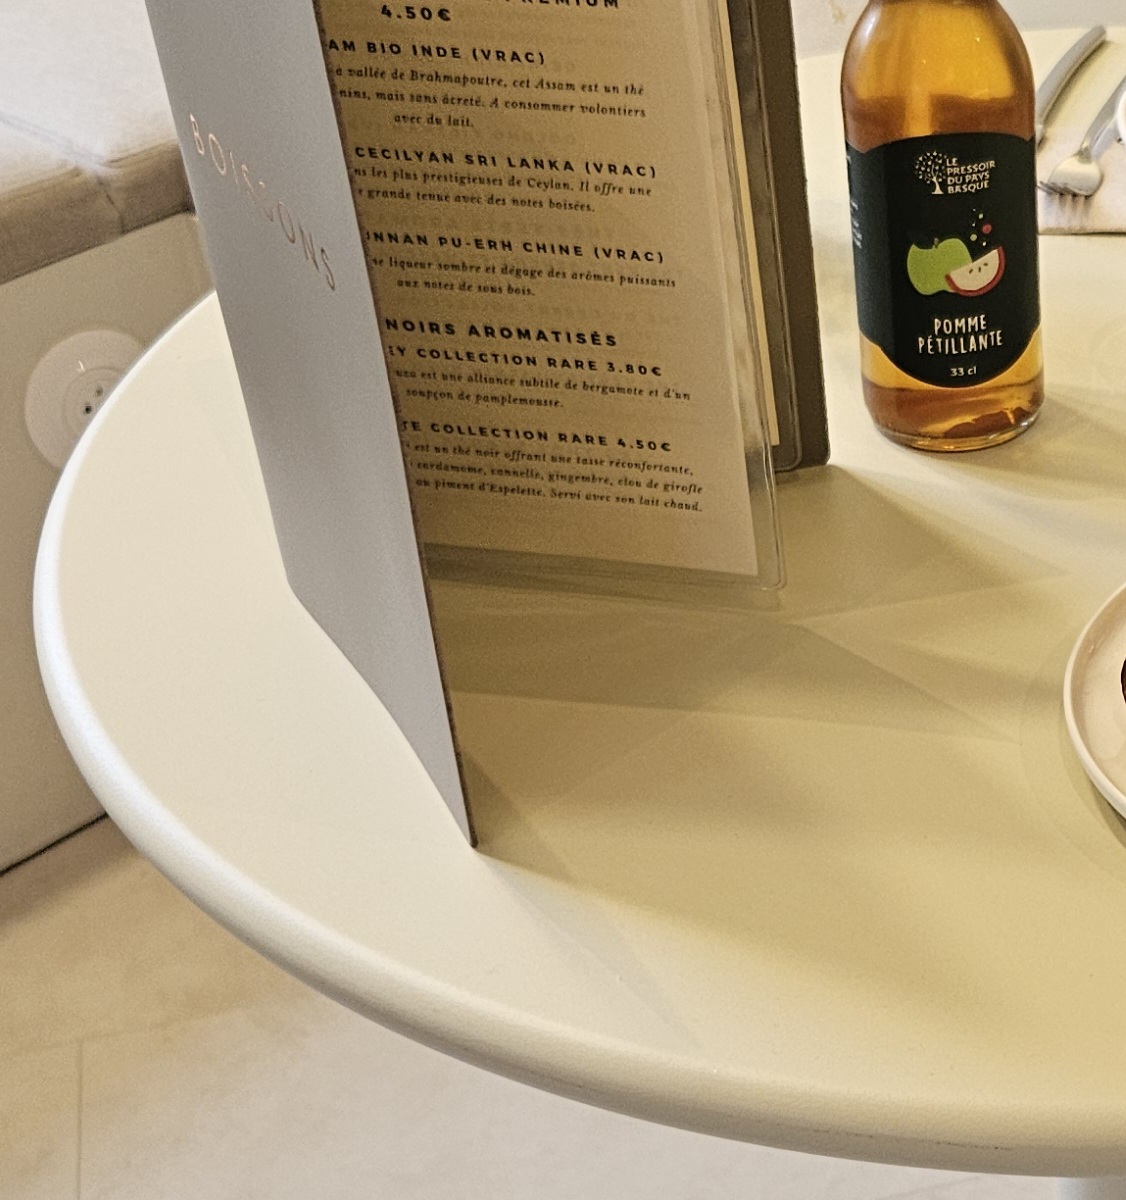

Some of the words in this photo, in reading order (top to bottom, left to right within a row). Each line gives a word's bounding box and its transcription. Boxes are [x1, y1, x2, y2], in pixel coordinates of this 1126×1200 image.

[381, 4, 451, 21] 4.50€
[328, 39, 356, 52] AM
[366, 42, 402, 55] BIO
[411, 44, 462, 59] INDE
[472, 48, 545, 65] (VRAC)
[348, 67, 387, 79] vallée
[391, 69, 406, 81] de
[410, 69, 508, 88] Brahmapoutre,
[512, 77, 531, 89] cet
[535, 78, 576, 92] Assam
[581, 81, 599, 93] est
[604, 84, 620, 95] un
[624, 82, 645, 96] thé
[339, 88, 371, 101] nins,
[375, 90, 405, 102] mais
[410, 94, 439, 104] sans
[504, 100, 575, 113] consommer
[580, 102, 647, 118] volontiers
[394, 114, 423, 125] avec
[427, 113, 442, 126] du
[354, 146, 455, 164] CECILYAN
[464, 154, 497, 167] SRI
[506, 156, 575, 172] LANKA
[585, 161, 656, 178] (VRAC)
[946, 157, 958, 166] LE
[947, 160, 996, 175] PRESSOIR
[371, 166, 388, 179] les
[392, 169, 418, 185] plus
[423, 172, 504, 187] prestigieuses
[508, 175, 522, 187] de
[579, 180, 590, 192] Il
[594, 182, 624, 196] offre
[629, 187, 652, 197] une
[947, 175, 963, 185] DU
[965, 171, 990, 183] PAYS
[947, 180, 990, 194] BASQUE
[367, 187, 412, 201] grande
[416, 191, 450, 202] tenue
[454, 194, 483, 205] avec
[487, 193, 507, 206] des
[512, 196, 544, 209] notes
[366, 231, 429, 246] NNAN
[438, 236, 513, 252] PU-ERH
[522, 241, 584, 257] CHINE
[594, 246, 664, 265] (VRAC)
[388, 256, 433, 270] liqueur
[437, 261, 481, 273] sombre
[485, 264, 496, 275] et
[501, 263, 544, 279] dégage
[547, 266, 567, 279] des
[571, 270, 615, 282] arômes
[619, 273, 676, 288] puissants
[397, 279, 418, 288] aux
[423, 280, 455, 291] notes
[459, 280, 473, 292] de
[477, 284, 503, 295] sous
[507, 284, 536, 296] bois.
[385, 318, 456, 336] NOIRS
[468, 324, 617, 347] AROMATISÉS
[934, 314, 987, 336] POMME
[918, 330, 1003, 355] PÉTILLANTE
[416, 348, 538, 367] COLLECTION
[547, 357, 598, 371] RARE
[606, 362, 662, 377] 3.80€
[950, 367, 965, 377] 33
[967, 365, 977, 375] cl
[405, 388, 453, 401] soupçon
[458, 390, 471, 400] de
[421, 371, 437, 380] est
[442, 373, 463, 382] une
[467, 373, 516, 386] alliance
[519, 377, 559, 389] subtile
[565, 379, 578, 390] de
[582, 381, 644, 396] bergamote
[649, 387, 659, 398] et
[401, 420, 422, 432] TE
[430, 423, 549, 441] COLLECTION
[558, 432, 608, 446] RARE
[617, 438, 672, 452] 4.50€
[414, 443, 430, 452] est
[434, 445, 449, 454] un
[452, 444, 471, 456] thé
[475, 448, 501, 458] noir
[504, 450, 546, 462] offrant
[551, 455, 572, 464] une
[576, 456, 605, 466] tasse
[434, 479, 475, 491] piment
[550, 489, 581, 501] Servi
[585, 493, 611, 502] avec
[615, 495, 635, 504] son
[639, 495, 660, 507] lait
[617, 477, 642, 488] clou
[646, 478, 659, 489] de
[663, 481, 704, 495] girofle
